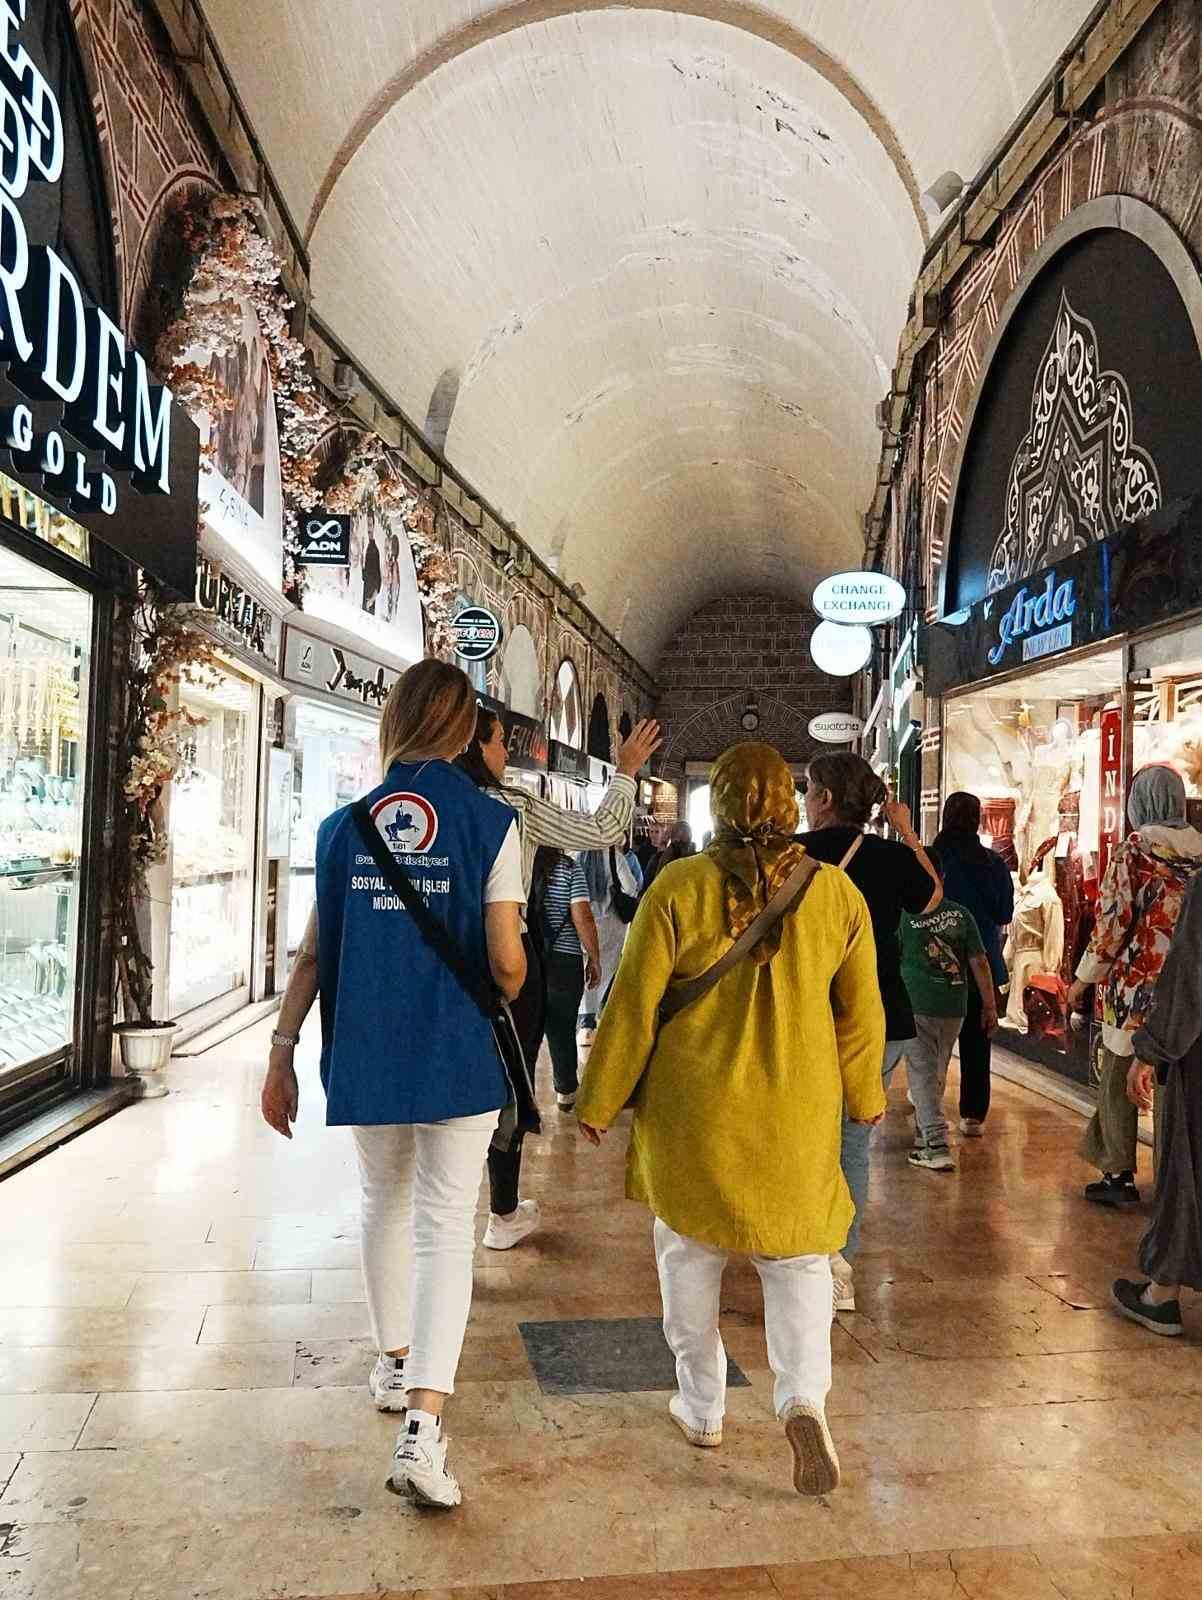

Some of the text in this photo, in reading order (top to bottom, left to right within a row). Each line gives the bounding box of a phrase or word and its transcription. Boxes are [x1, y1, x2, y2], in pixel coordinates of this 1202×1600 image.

[12, 403, 118, 517] GOLD
[305, 540, 341, 552] ADN
[831, 584, 886, 595] CHANGE
[823, 600, 895, 611] EXCHANGE
[988, 568, 1076, 665] Arda
[815, 722, 851, 731] swatch
[351, 876, 386, 890] SOSYAL
[422, 876, 450, 896] İŞLERİ
